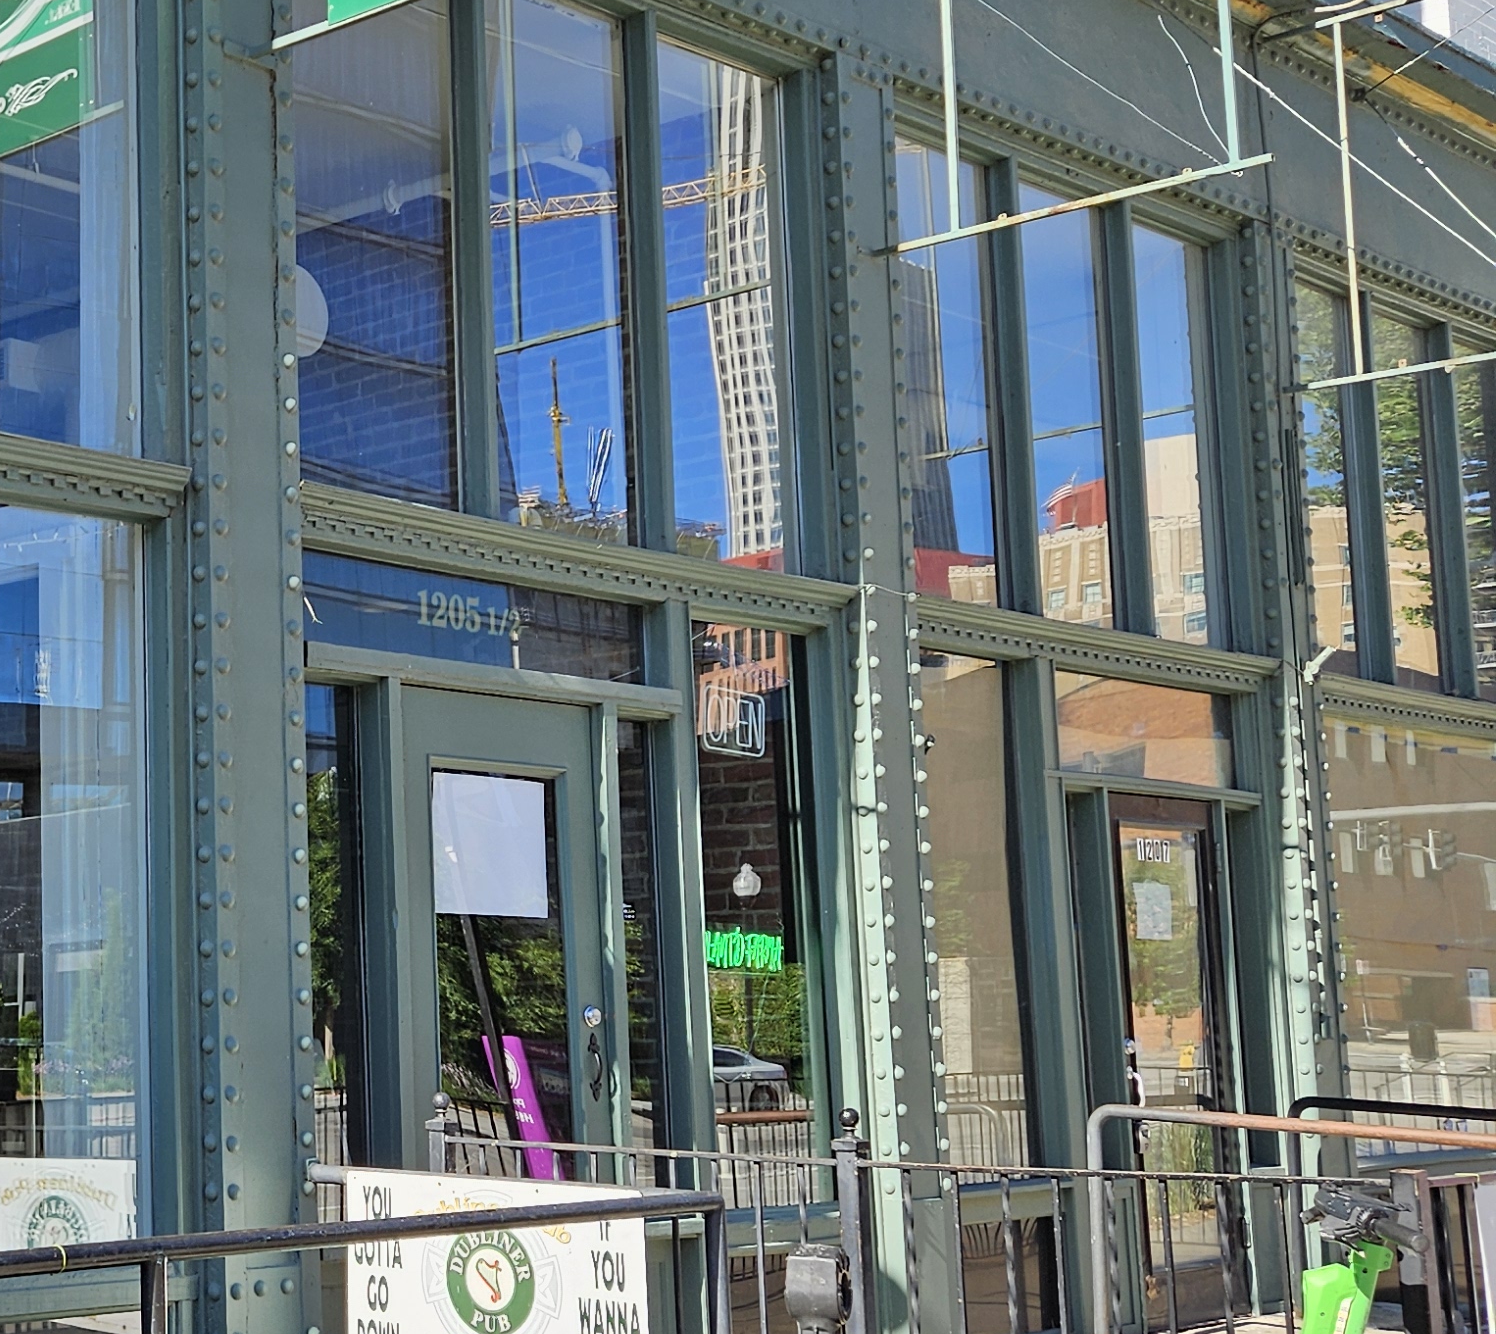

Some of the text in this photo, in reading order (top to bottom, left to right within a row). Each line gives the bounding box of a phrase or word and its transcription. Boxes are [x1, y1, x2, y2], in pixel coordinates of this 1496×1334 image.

[417, 589, 482, 633] 1205
[707, 694, 762, 750] OPEN
[1136, 838, 1170, 863] 1207
[363, 1185, 392, 1219] YOU
[449, 1229, 531, 1284] DUBLINER
[590, 1249, 626, 1293] YOU
[367, 1274, 389, 1313] GO
[470, 1308, 512, 1334] PUB
